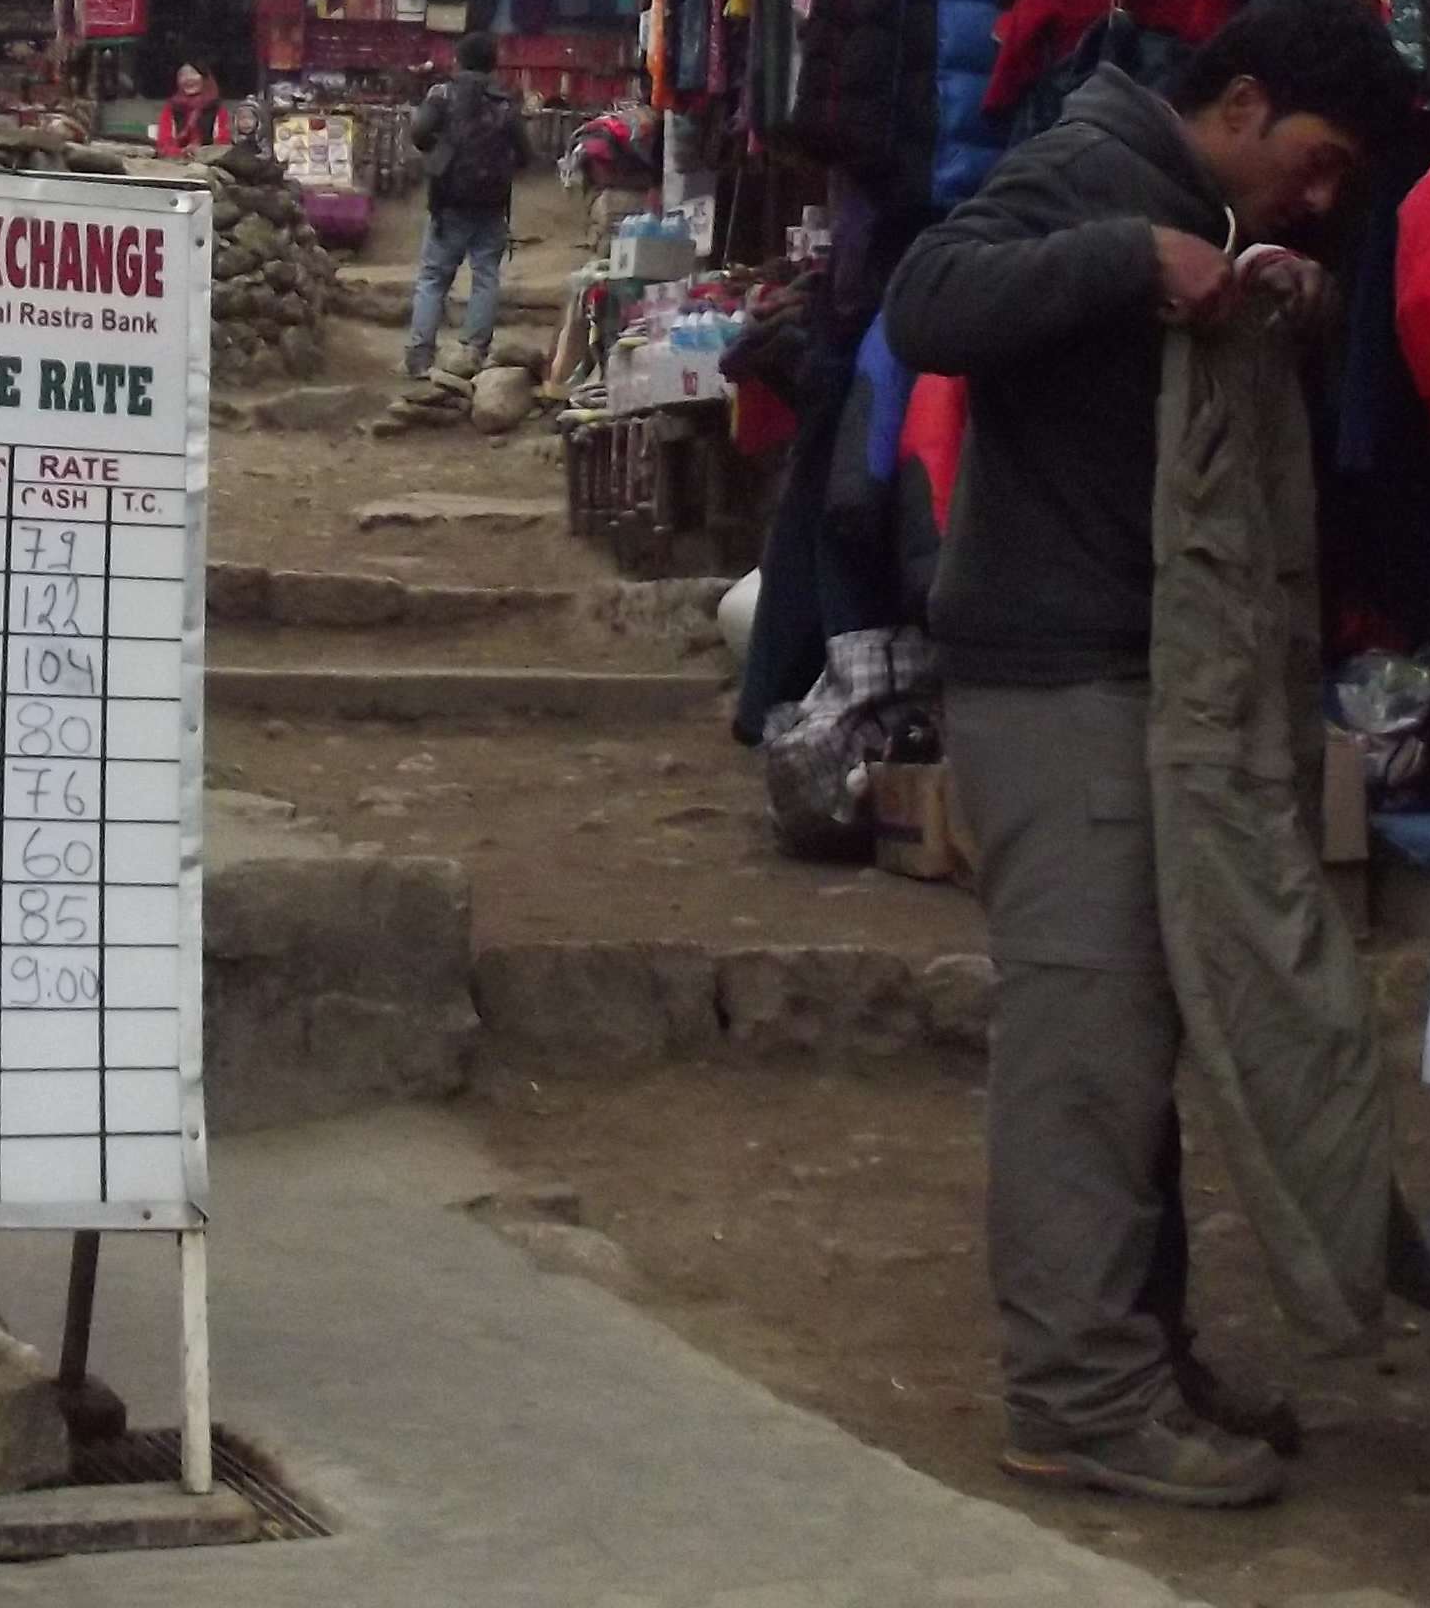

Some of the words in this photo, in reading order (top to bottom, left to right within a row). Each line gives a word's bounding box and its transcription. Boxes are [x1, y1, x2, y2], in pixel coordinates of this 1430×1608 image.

[19, 301, 94, 331] Rastra
[101, 308, 159, 335] Bank
[38, 357, 154, 417] RATE
[38, 454, 120, 483] RATE
[121, 491, 163, 514] T.C.
[20, 526, 77, 572] 79
[22, 573, 83, 638] 122
[22, 646, 97, 694] 104
[16, 701, 93, 757] 80
[11, 768, 86, 817] 76
[22, 825, 94, 879] 60
[18, 887, 88, 944] 85
